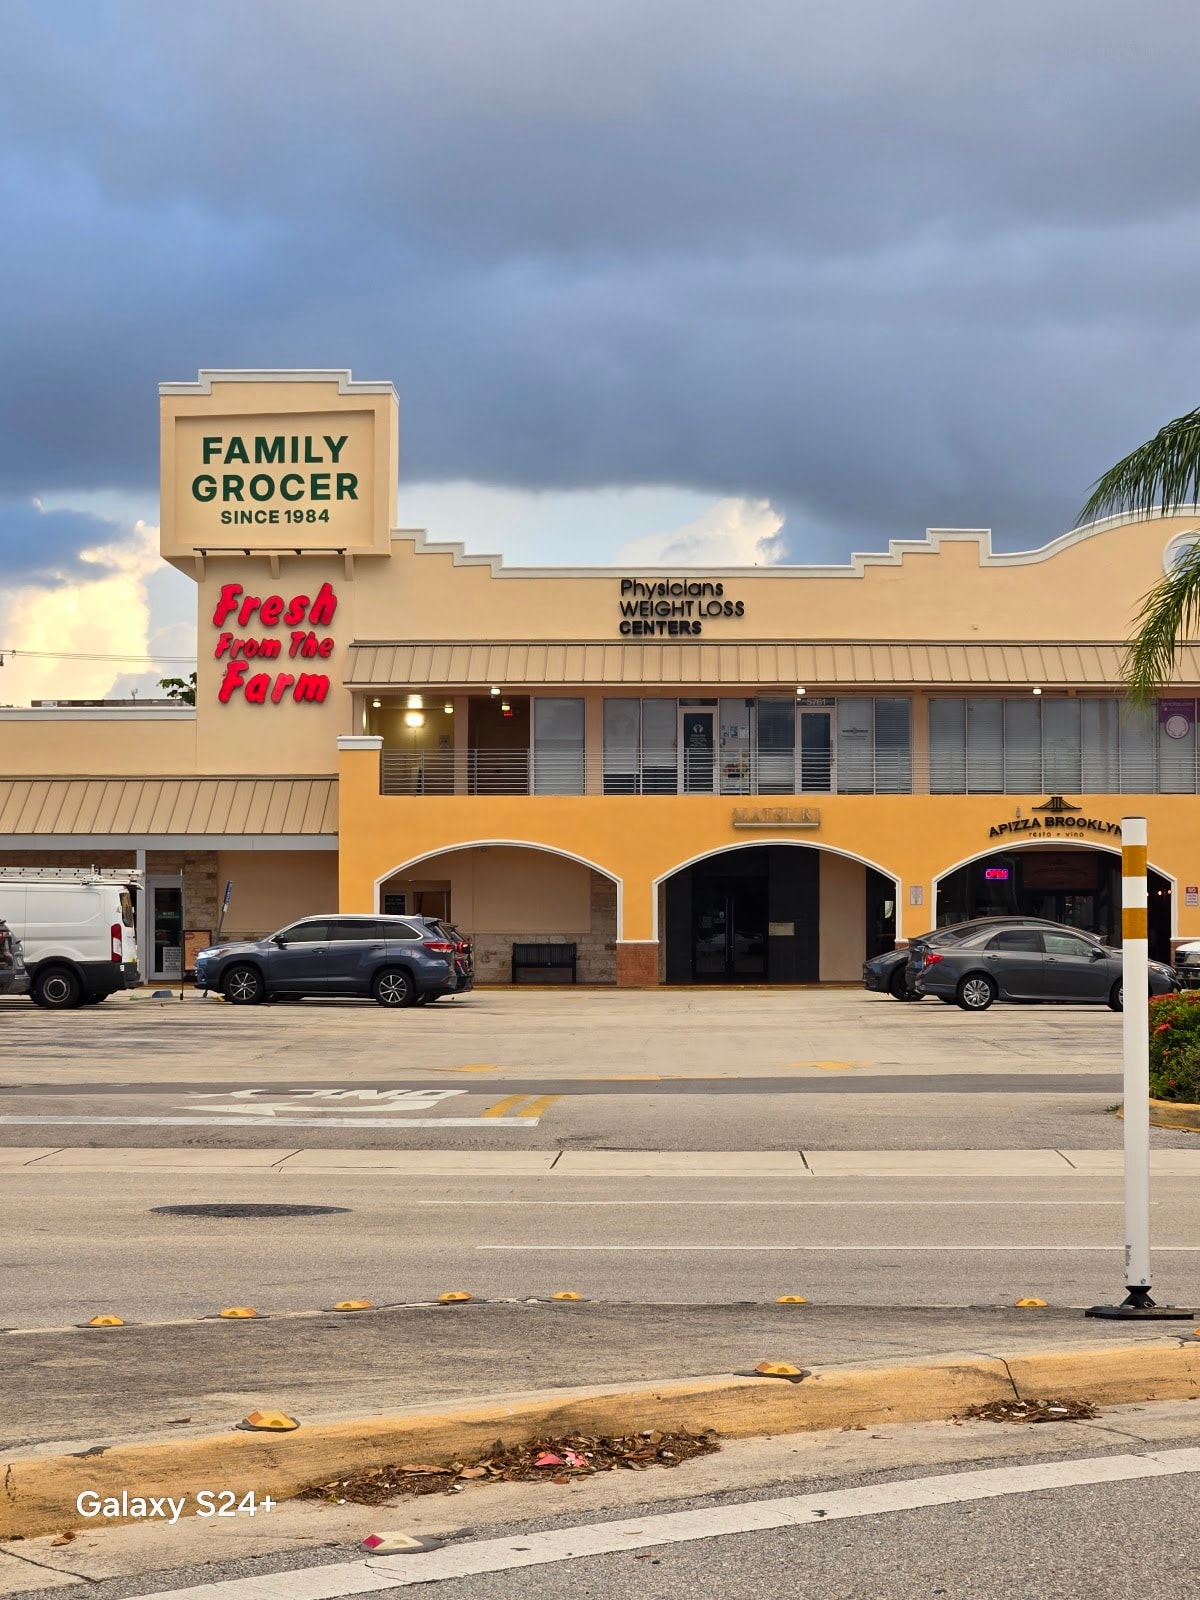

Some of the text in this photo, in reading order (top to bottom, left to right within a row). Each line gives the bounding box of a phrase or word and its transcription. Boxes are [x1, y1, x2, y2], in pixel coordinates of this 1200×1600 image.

[202, 435, 349, 465] FAMILY
[191, 472, 359, 502] GROCER
[220, 509, 330, 524] SINCE 1984
[620, 578, 724, 600] Physicians
[212, 582, 338, 628] Fresh
[619, 600, 745, 617] WEIGHT LOSS
[619, 620, 702, 635] CENTERS
[214, 631, 335, 659] From The
[218, 659, 330, 704] Farm
[733, 807, 821, 821] MATSURI
[989, 818, 1042, 838] APIZZA
[985, 870, 1008, 878] OPEN
